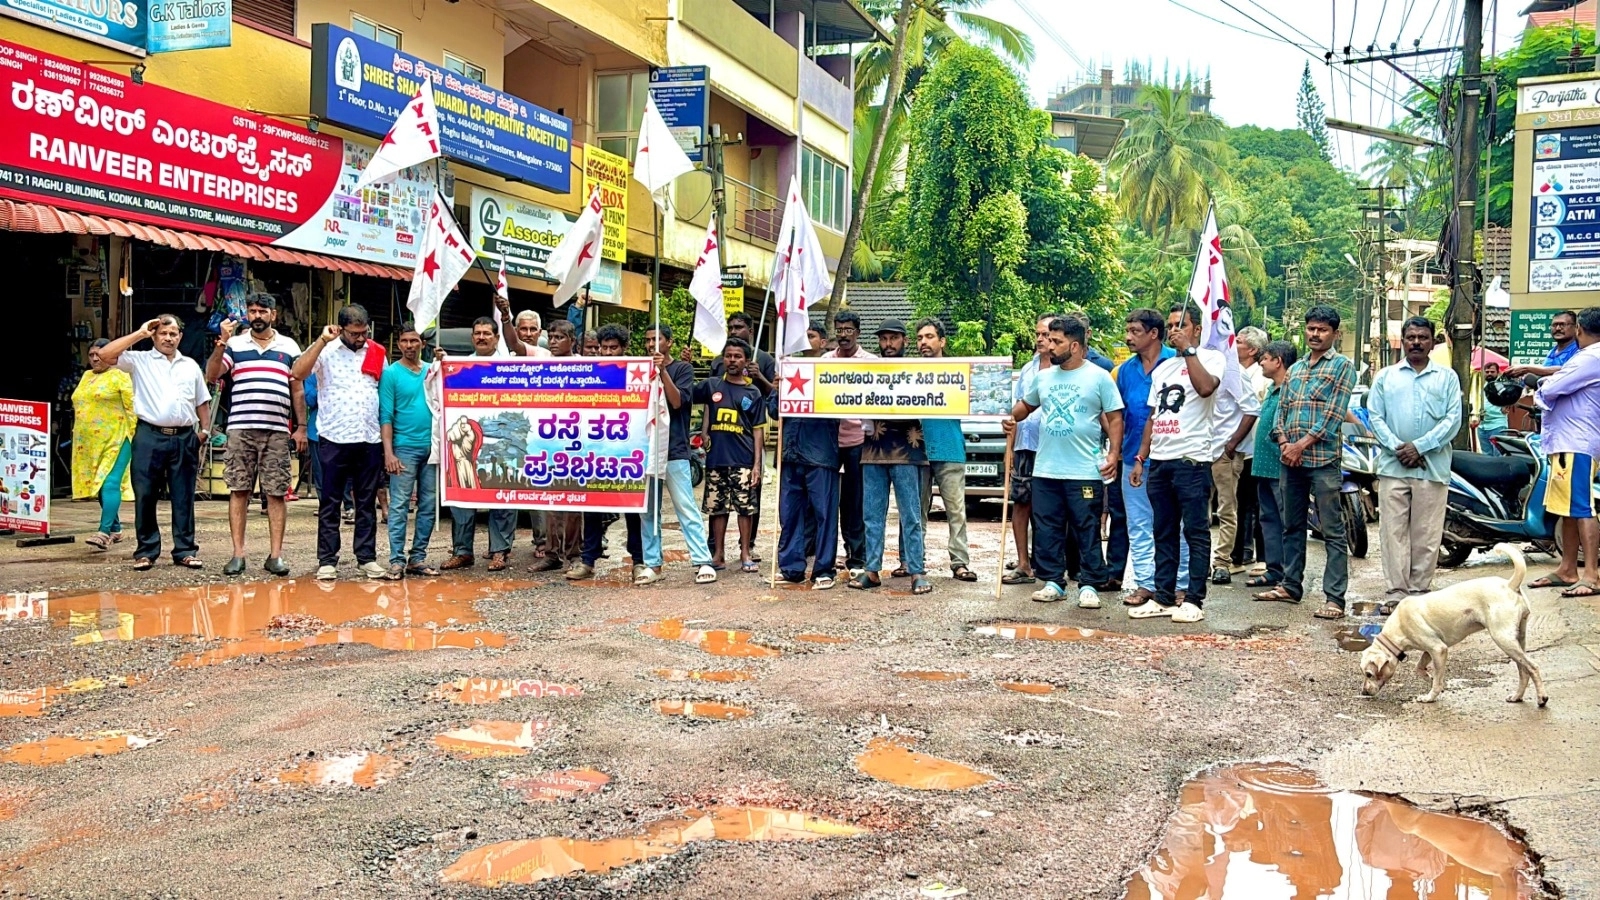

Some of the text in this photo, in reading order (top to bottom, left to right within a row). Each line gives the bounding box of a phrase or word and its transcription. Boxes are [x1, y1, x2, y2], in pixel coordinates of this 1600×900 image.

[151, 0, 226, 22] G.K Tailors
[55, 9, 77, 24] Ladies
[78, 17, 83, 25] &
[84, 18, 103, 31] Gents
[170, 22, 185, 31] Ladies
[192, 21, 205, 29] Gents
[15, 48, 38, 63] SINGH
[1531, 87, 1587, 109] Parijatha
[363, 63, 395, 90] SHREE
[434, 89, 469, 116] UHARDA
[470, 103, 526, 137] CO-OPERATIVE
[526, 124, 555, 149] SOCIETY
[556, 135, 569, 153] LTD
[233, 115, 257, 131] GSTIN
[1548, 109, 1600, 123] Sai Ass
[347, 93, 367, 109] Floor,
[442, 125, 460, 139] Raghu
[461, 129, 485, 149] Building,
[516, 151, 542, 167] Mangalore
[545, 160, 563, 174] 575006
[440, 144, 456, 154] ervice
[29, 132, 298, 214] RANVEER ENTERPRISES
[14, 172, 23, 184] 12
[32, 176, 63, 192] RAGHU
[65, 183, 107, 201] BUILDING,
[109, 191, 142, 208] KODIKAL
[144, 199, 167, 213] ROAD,
[169, 204, 188, 216] URVA
[190, 208, 213, 222] STORE,
[587, 183, 625, 210] XROX
[1568, 196, 1594, 204] M.C.C
[608, 210, 625, 227] PRINT
[1566, 208, 1596, 221] ATM
[1566, 232, 1592, 240] M.C.C
[496, 242, 537, 259] Engineers &
[617, 241, 624, 250] OF
[400, 251, 417, 260] BOSCH
[601, 248, 616, 258] SIGN
[818, 370, 966, 390] ಮಂಗಳೂರು ಸ್ಮಾರ್ಟ್ ಸಿಟಿ ದುಡ್ಡು
[626, 384, 650, 393] DYFI
[1049, 384, 1081, 393] SERVICE
[834, 392, 863, 406] ಯಾರ
[865, 391, 893, 406] ಜೇಬು
[0, 403, 34, 415] RANVEER
[780, 401, 813, 413] DYFI
[0, 414, 42, 426] TERPRISES
[1154, 419, 1179, 427] QUILAB
[537, 411, 630, 451] ರಸ್ತೆ ತಡೆ
[711, 422, 744, 434] muthoot
[524, 449, 646, 487] ಪ್ರತಿಭಟನೆ
